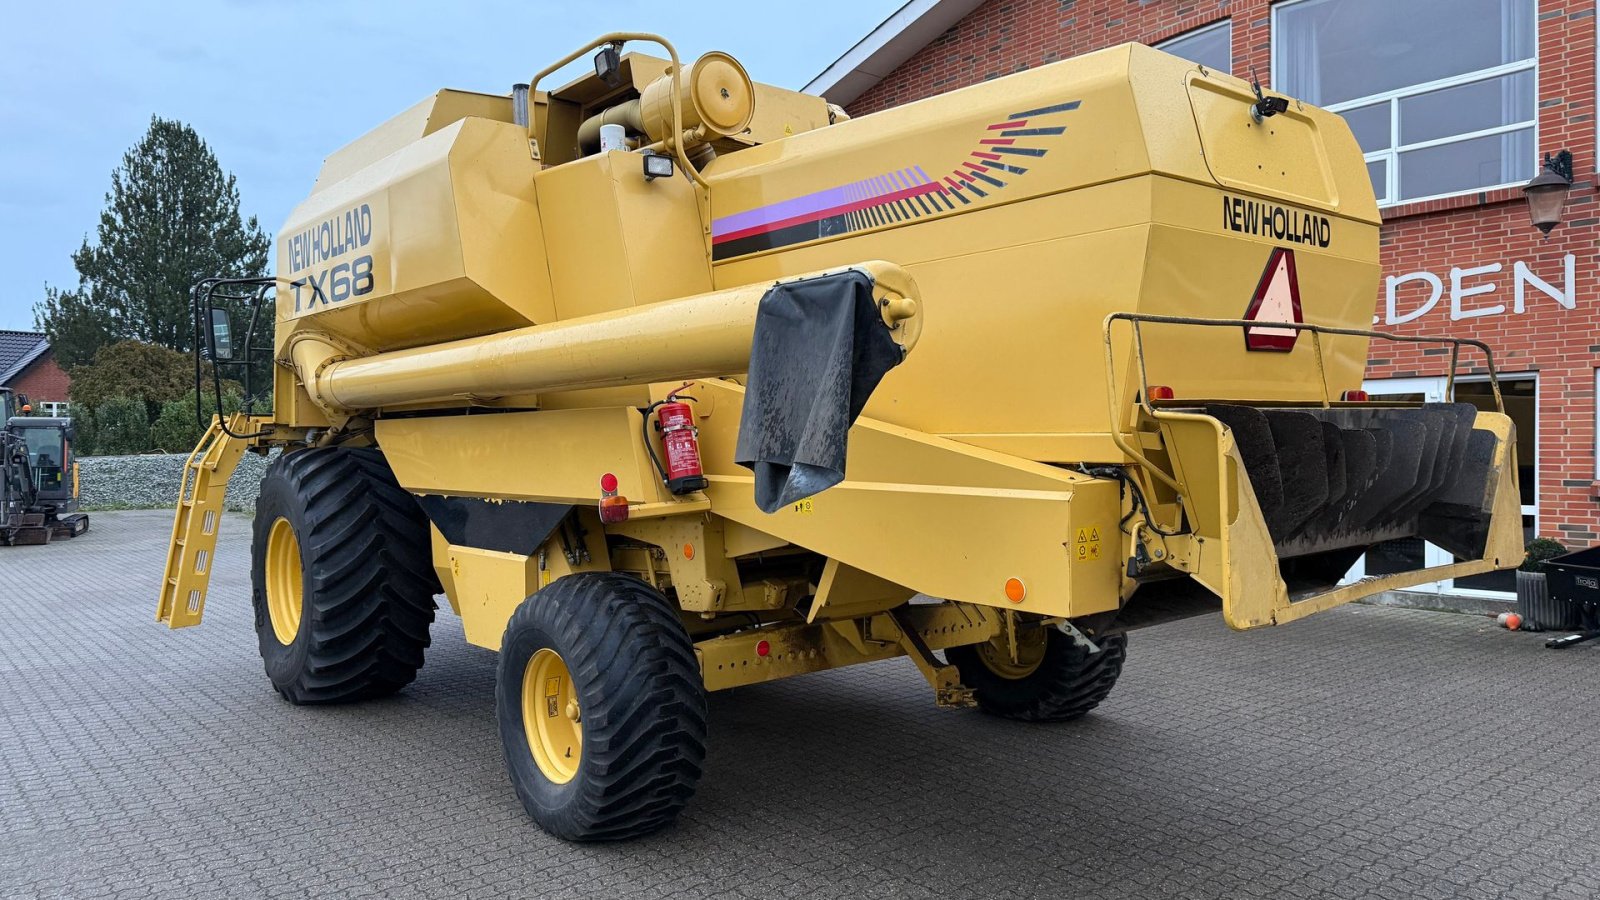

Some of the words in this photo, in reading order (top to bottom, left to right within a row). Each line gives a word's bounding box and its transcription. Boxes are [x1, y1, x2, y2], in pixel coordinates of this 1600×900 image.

[288, 229, 311, 275] NEW
[312, 203, 372, 265] HOLLAND
[1223, 195, 1259, 235] NEW
[1262, 203, 1331, 248] HOLLAND
[289, 254, 374, 312] TX68
[1373, 253, 1577, 326] DEN
